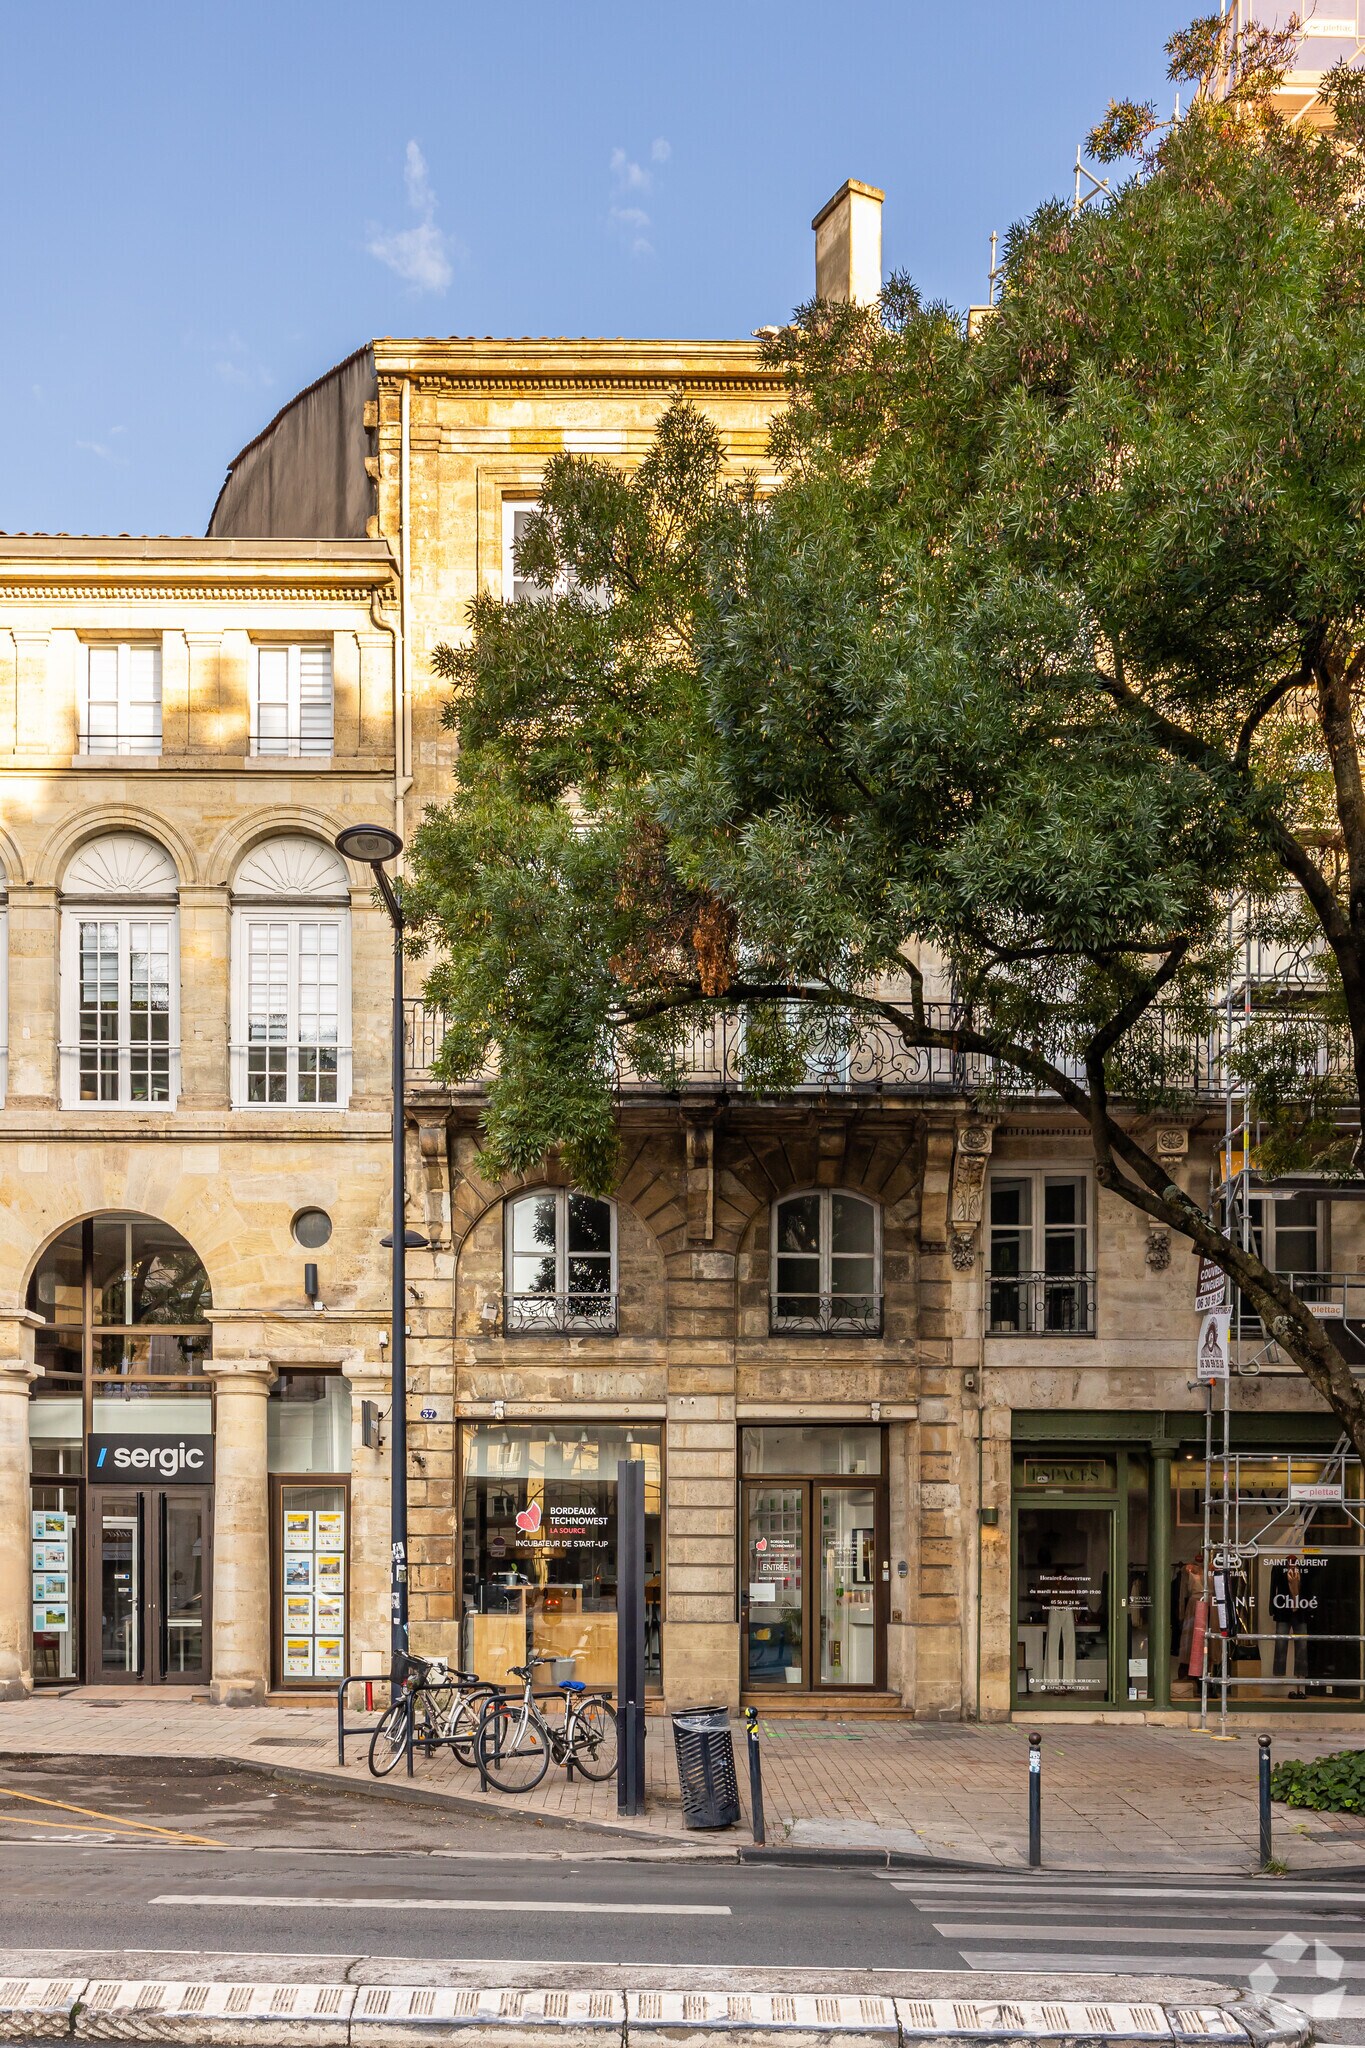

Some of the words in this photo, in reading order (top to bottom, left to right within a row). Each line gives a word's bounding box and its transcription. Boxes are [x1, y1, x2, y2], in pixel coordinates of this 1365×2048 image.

[423, 1410, 435, 1418] 37
[113, 1441, 204, 1477] sergic
[1032, 1468, 1099, 1481] ESPACES
[1309, 1489, 1339, 1497] plettac
[550, 1507, 596, 1515] BORDEAUX
[550, 1517, 608, 1525] TECHNOWEST
[573, 1540, 609, 1548] START-UP
[762, 1562, 788, 1571] ENTRÉE
[1263, 1558, 1287, 1566] SAINT
[1289, 1558, 1329, 1567] LAURENT
[1273, 1594, 1318, 1609] Chloé
